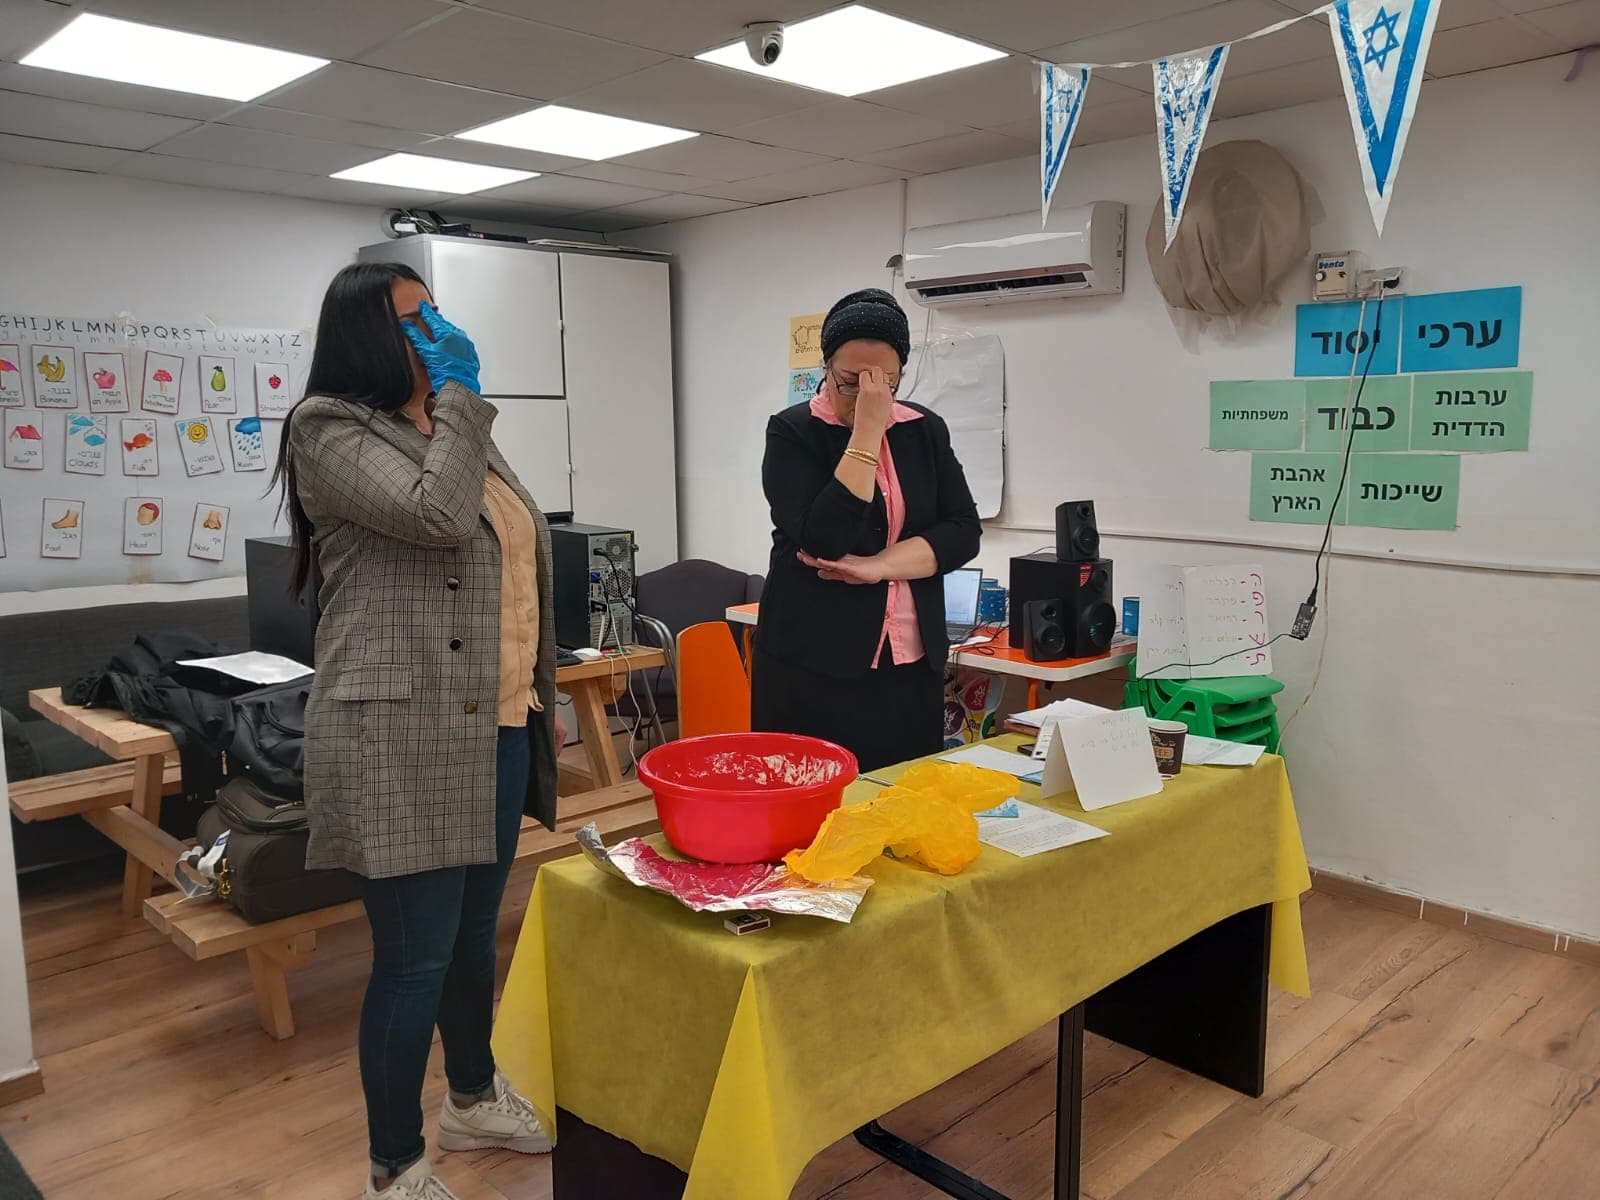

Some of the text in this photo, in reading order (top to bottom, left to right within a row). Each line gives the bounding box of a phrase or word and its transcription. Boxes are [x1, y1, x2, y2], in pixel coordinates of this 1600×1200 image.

[1311, 319, 1502, 355] ערכי יסוד
[1435, 389, 1507, 406] ערבות
[1221, 409, 1289, 421] משפחתיות
[1317, 405, 1396, 431] כבוד
[1432, 420, 1505, 437] הדדית
[1270, 467, 1326, 482] אהבת
[1361, 482, 1442, 502] שייכות
[1272, 493, 1321, 512] הארץ
